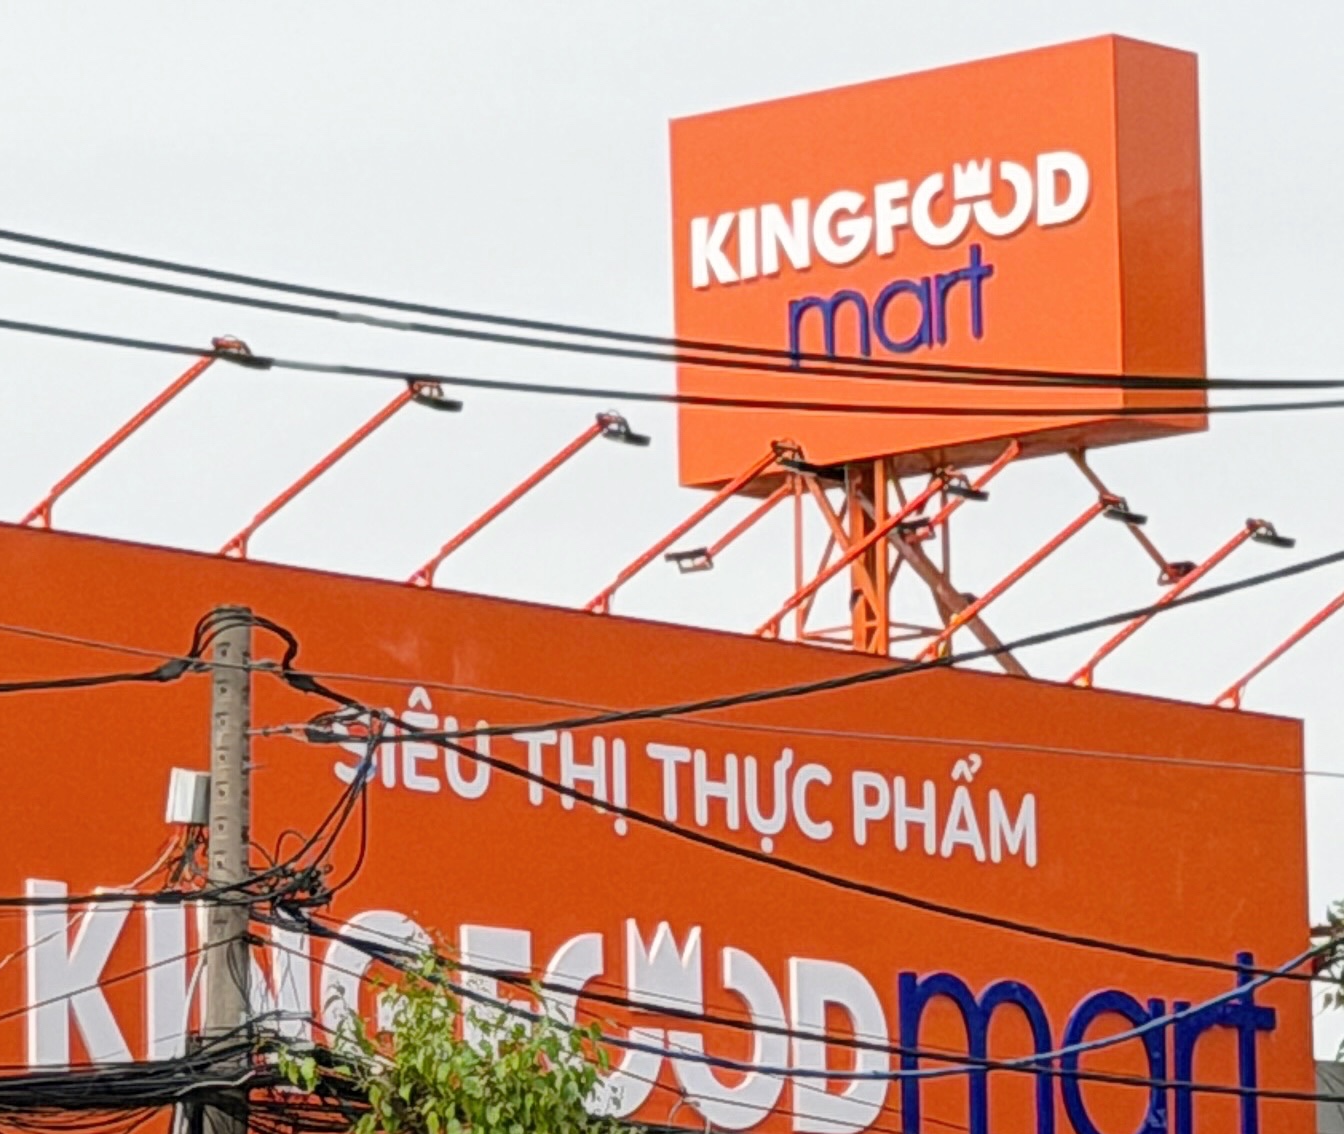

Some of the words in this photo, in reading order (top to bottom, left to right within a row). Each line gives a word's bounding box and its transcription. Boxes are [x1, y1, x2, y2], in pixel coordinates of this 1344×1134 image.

[690, 150, 1090, 289] KINGFOOD
[788, 243, 994, 369] mart
[334, 686, 491, 799] SIÊU
[511, 728, 628, 836] THỊ
[645, 741, 833, 853] THỰC
[851, 753, 1038, 868] PHẨM
